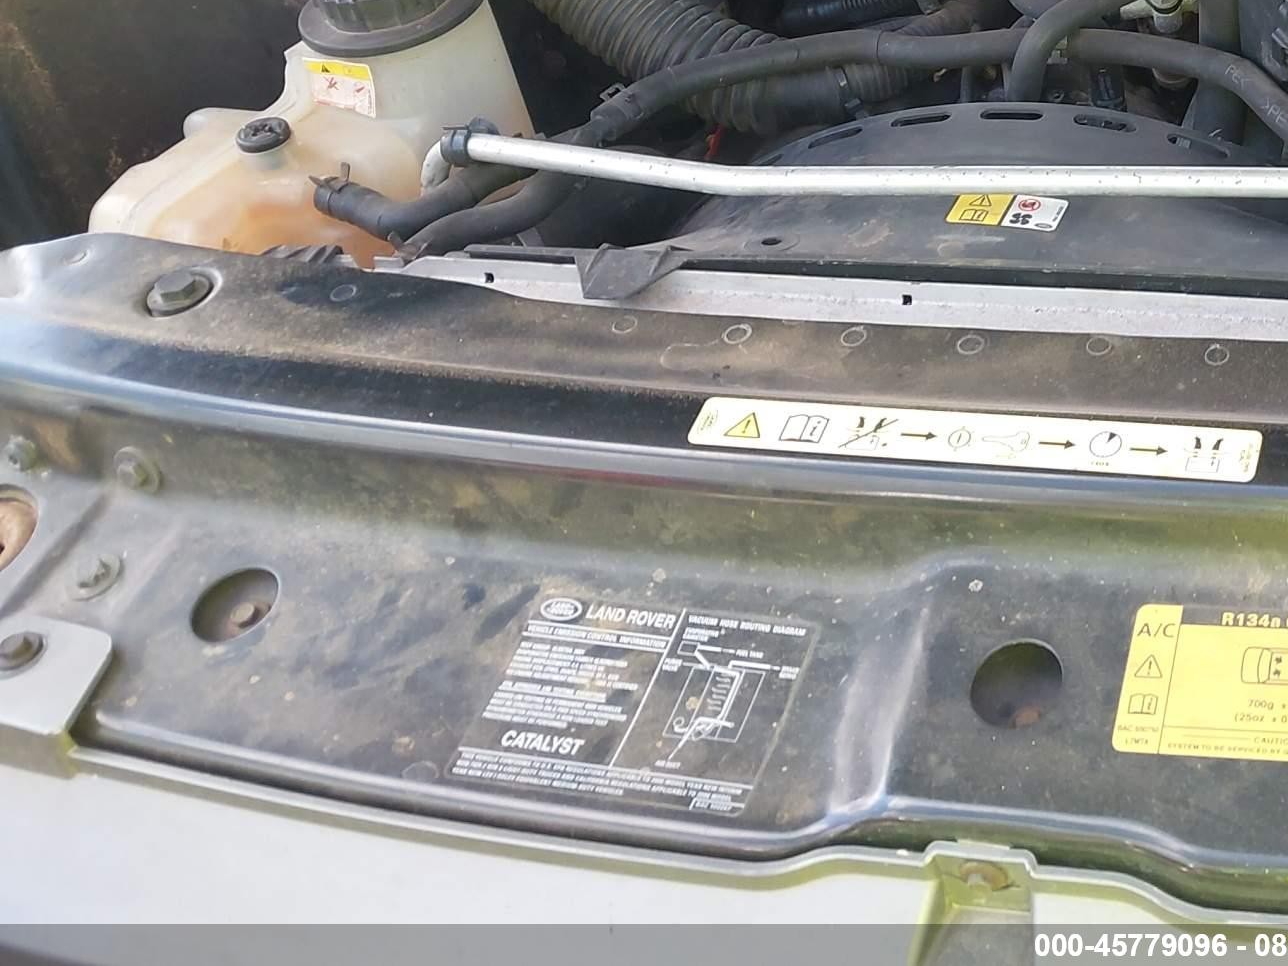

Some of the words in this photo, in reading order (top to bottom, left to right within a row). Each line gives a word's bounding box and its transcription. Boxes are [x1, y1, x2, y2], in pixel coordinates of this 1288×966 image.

[586, 604, 626, 623] LAND
[626, 612, 676, 629] ROVER
[688, 615, 719, 626] VACUUM
[719, 619, 739, 630] HOSE
[740, 621, 772, 633] ROUTING
[773, 624, 807, 636] DIAGRAM
[1221, 611, 1281, 629] R134a
[1137, 622, 1176, 638] A/C
[501, 730, 585, 756] CATALYST
[1168, 742, 1200, 750] SYSTEM
